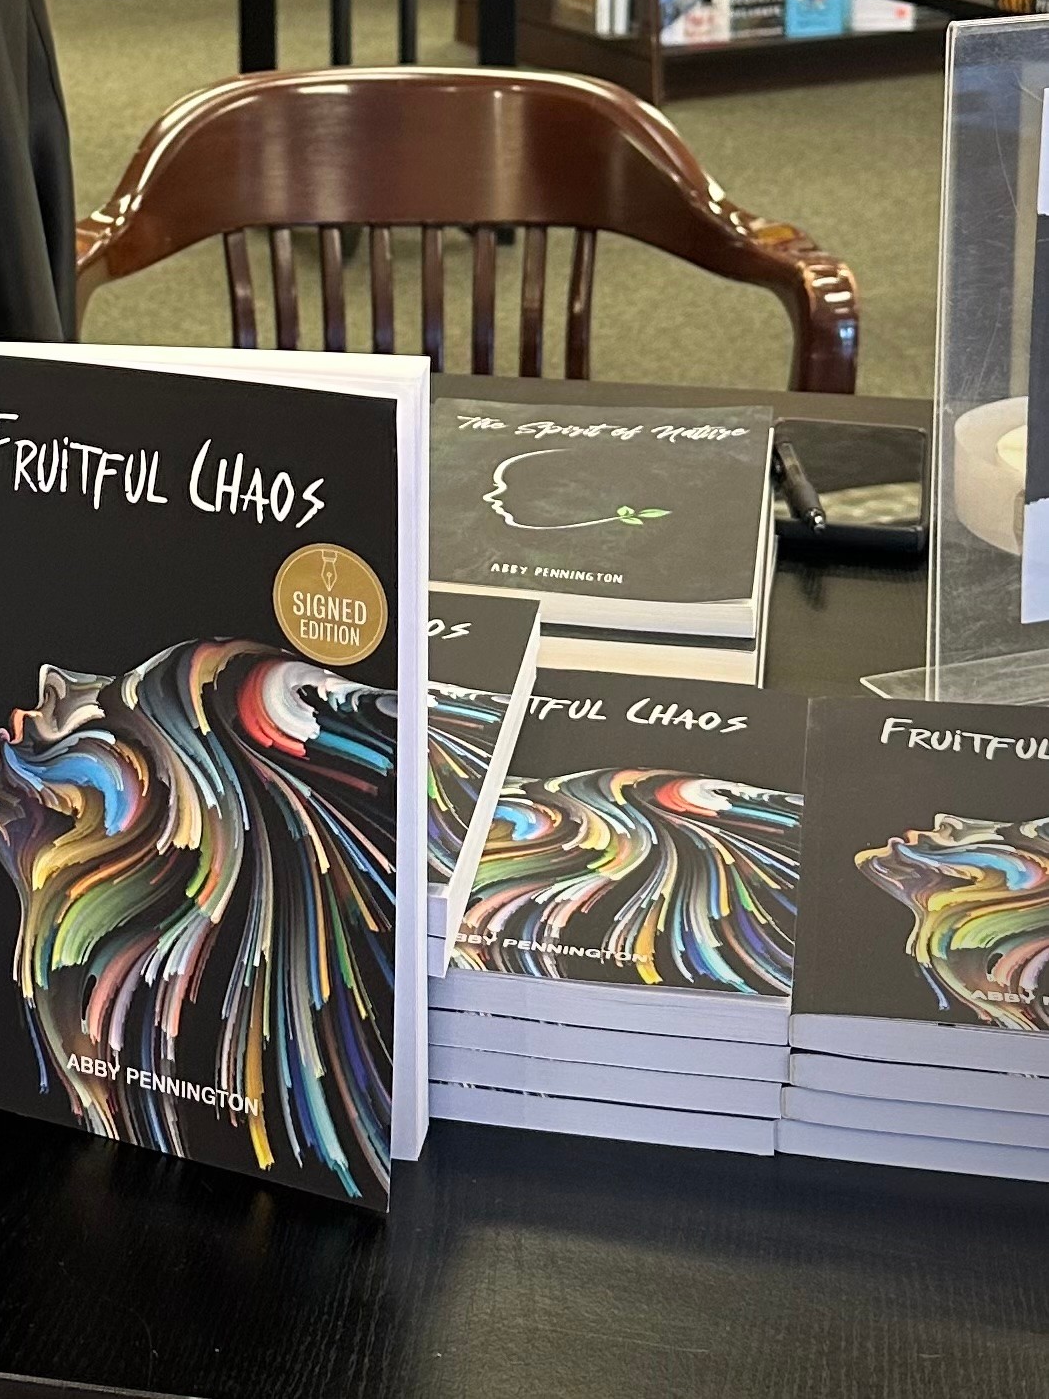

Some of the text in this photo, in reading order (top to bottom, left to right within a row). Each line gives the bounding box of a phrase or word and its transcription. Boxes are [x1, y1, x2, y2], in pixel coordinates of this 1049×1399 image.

[456, 414, 750, 443] The Spirit of Nature
[189, 438, 327, 529] CHAOS
[490, 563, 624, 585] ABBY PENNINGTON
[292, 590, 368, 625] SIGNED
[300, 618, 361, 647] EDITION
[626, 697, 749, 733] CHAOS
[502, 937, 654, 963] PENNINGTON
[970, 989, 1036, 1005] ABBY
[66, 1052, 260, 1117] ABBY PENNINGTON
